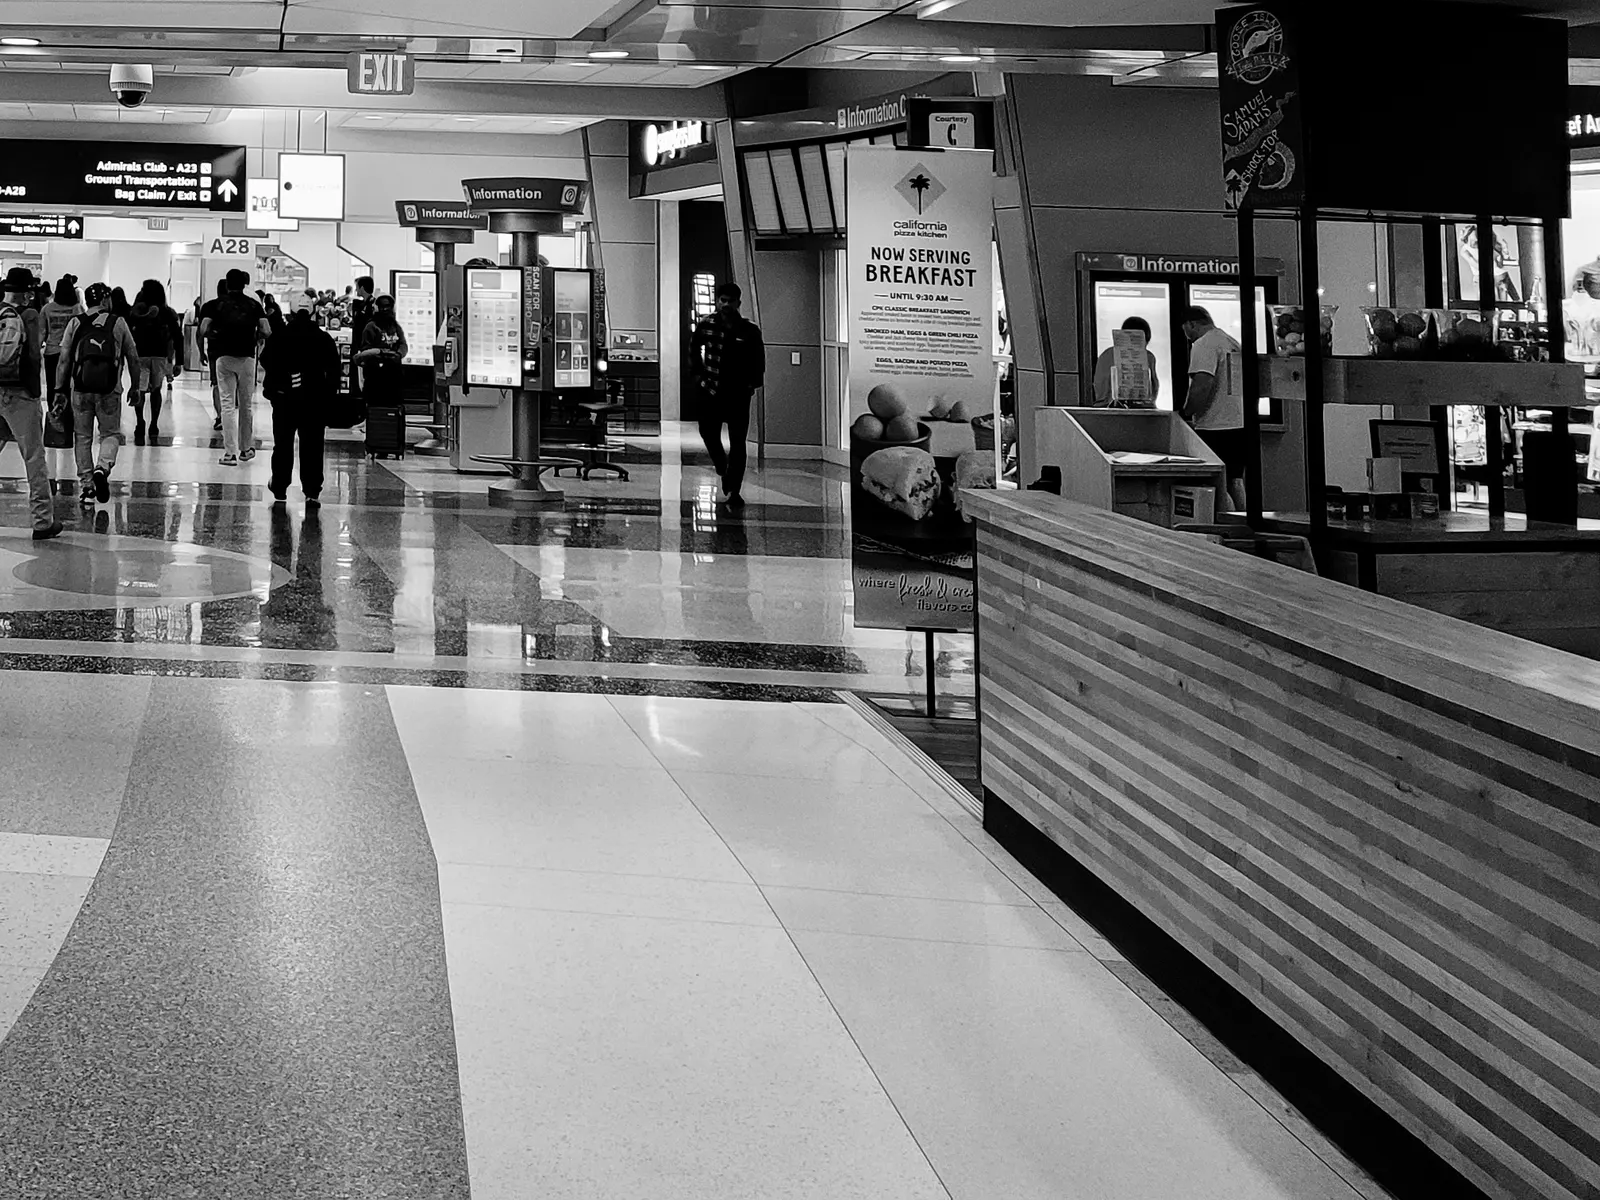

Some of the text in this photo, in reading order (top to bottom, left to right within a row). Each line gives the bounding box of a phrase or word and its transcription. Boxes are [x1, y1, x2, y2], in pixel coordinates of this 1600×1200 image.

[359, 54, 407, 91] EXIT
[847, 99, 899, 128] Information
[1223, 89, 1273, 138] SAMUEL
[1238, 105, 1272, 142] ADAMS
[97, 161, 142, 172] Admirals
[143, 162, 167, 173] Club
[176, 163, 198, 173] A23
[85, 174, 198, 188] Ground Transportation
[115, 189, 135, 201] Bag
[137, 190, 166, 200] Claim
[177, 191, 197, 201] Exit
[472, 187, 542, 200] Information
[893, 219, 948, 231] california
[917, 231, 948, 239] kitchen
[211, 239, 249, 254] A28
[871, 246, 971, 265] NOW SERVING
[1142, 256, 1239, 274] Information
[866, 264, 977, 287] BREAKFAST
[532, 266, 540, 310] SCAN FOR
[890, 292, 914, 300] UNTIL
[935, 294, 949, 302] AM
[859, 576, 896, 589] where
[899, 573, 934, 606] fresh
[917, 598, 959, 611] flavors
